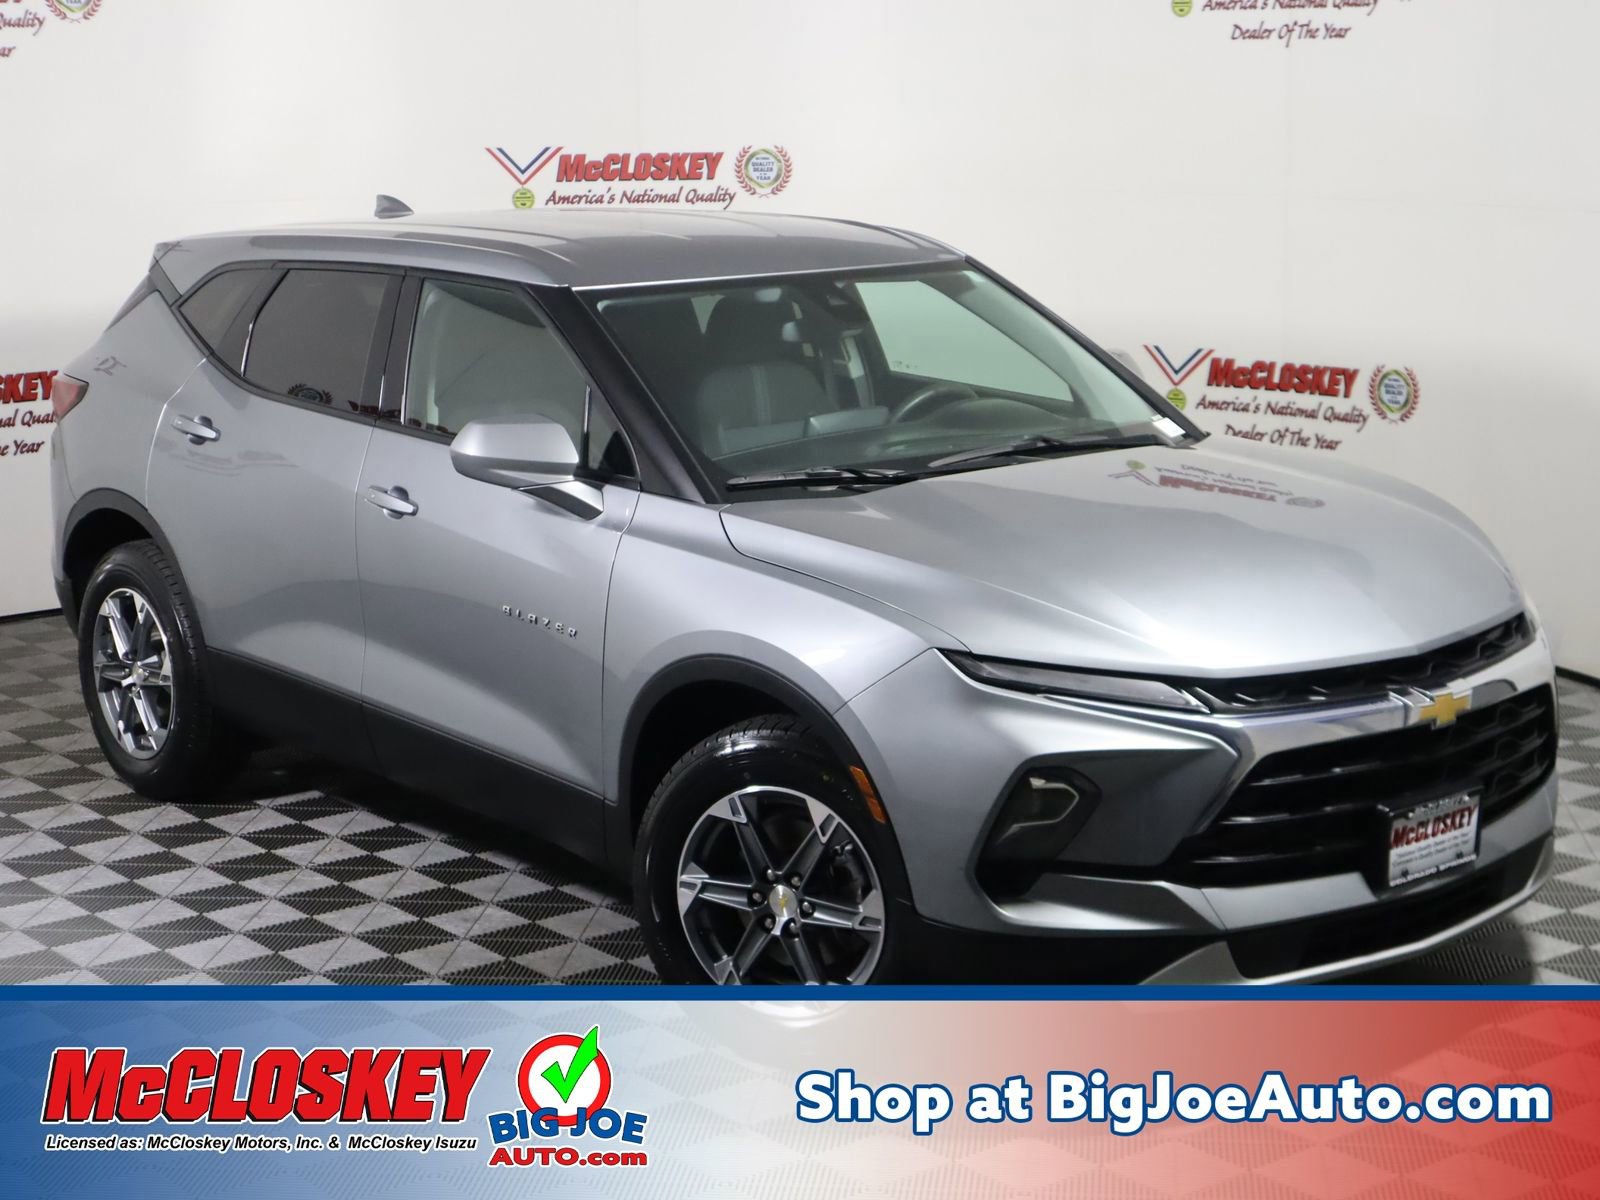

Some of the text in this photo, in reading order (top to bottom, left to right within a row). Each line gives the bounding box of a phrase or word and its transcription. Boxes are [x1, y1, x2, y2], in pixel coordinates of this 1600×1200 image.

[1201, 0, 1268, 11] Americas
[0, 9, 46, 37] uality
[1231, 20, 1352, 48] Dealer Of The Year
[556, 151, 724, 183] McCLOSKEY
[545, 187, 616, 206] America's
[619, 185, 684, 205] National
[685, 185, 736, 210] Quality
[1207, 357, 1360, 399] McCLOSKEY
[21, 410, 55, 427] Qual
[1195, 394, 1261, 415] America's
[1264, 400, 1323, 420] National
[1323, 404, 1370, 432] Quality
[13, 439, 45, 456] Year
[1225, 424, 1343, 450] Dealer Of The Year
[502, 605, 578, 639] BLAZER
[1390, 803, 1479, 850] McCLOSKEY
